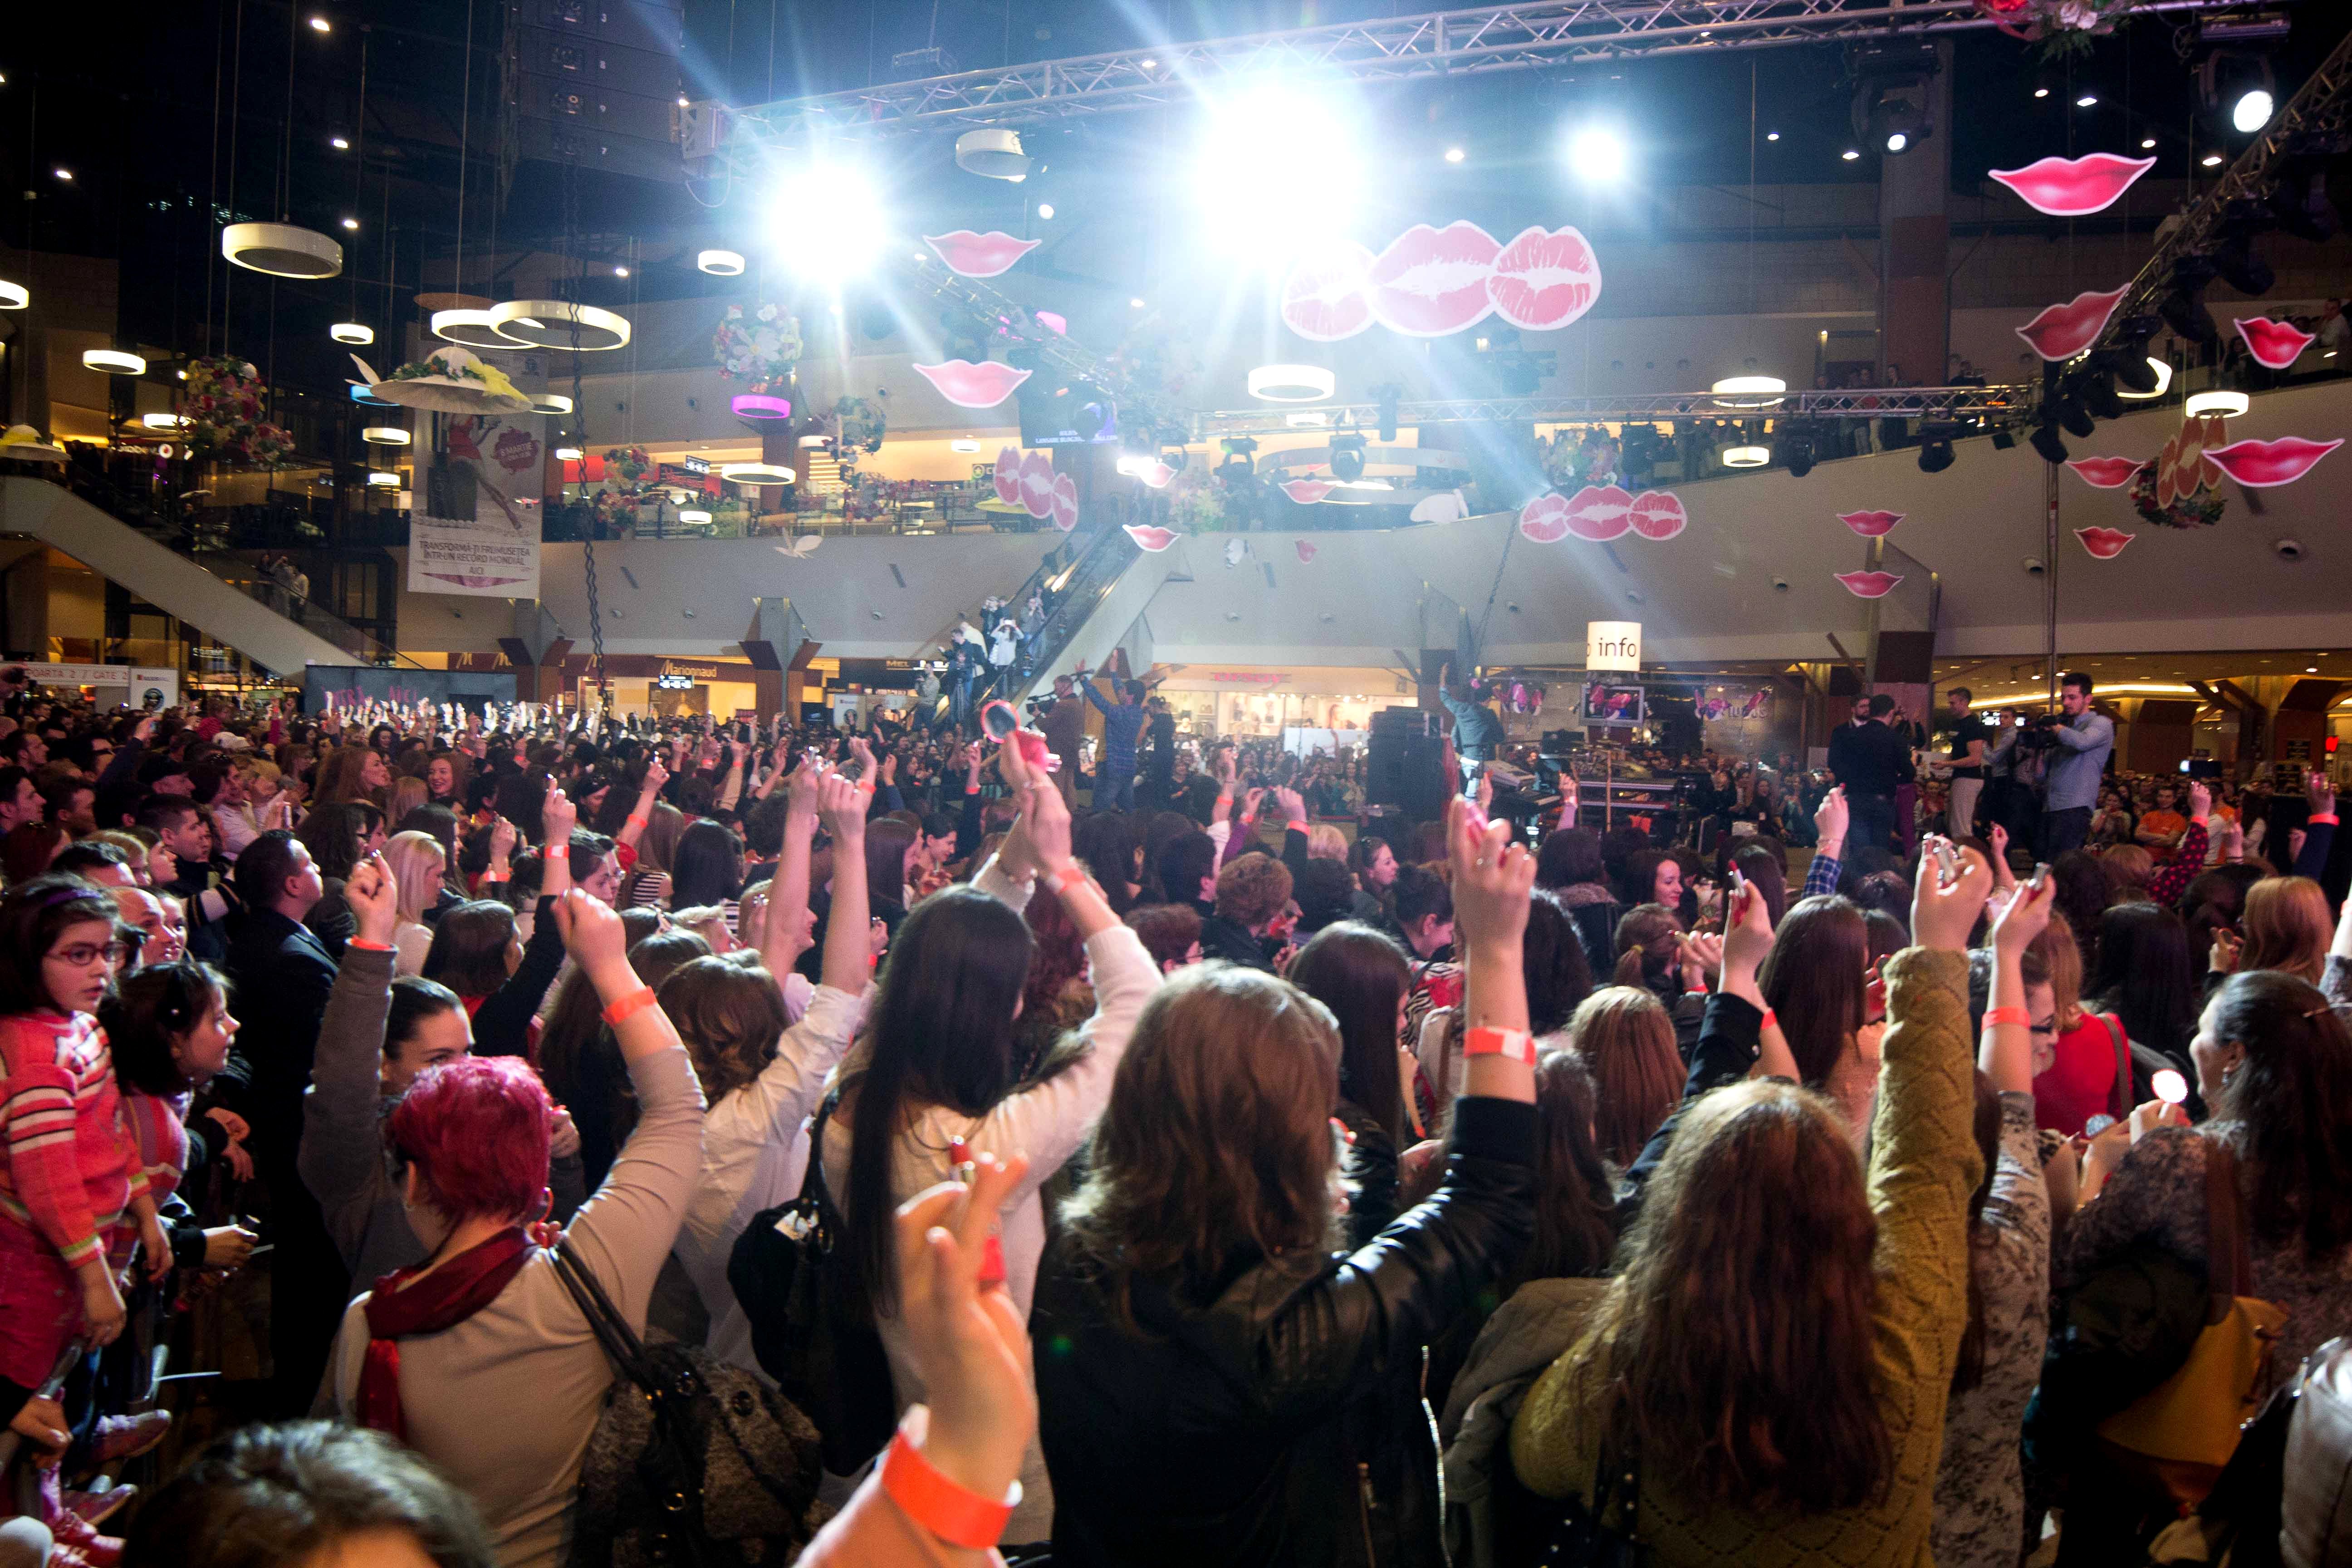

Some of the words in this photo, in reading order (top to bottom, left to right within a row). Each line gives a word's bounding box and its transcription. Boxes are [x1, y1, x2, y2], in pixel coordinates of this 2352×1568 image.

[1598, 637, 1637, 657] info
[93, 671, 117, 680] GATE
[1213, 672, 1284, 691] orsay
